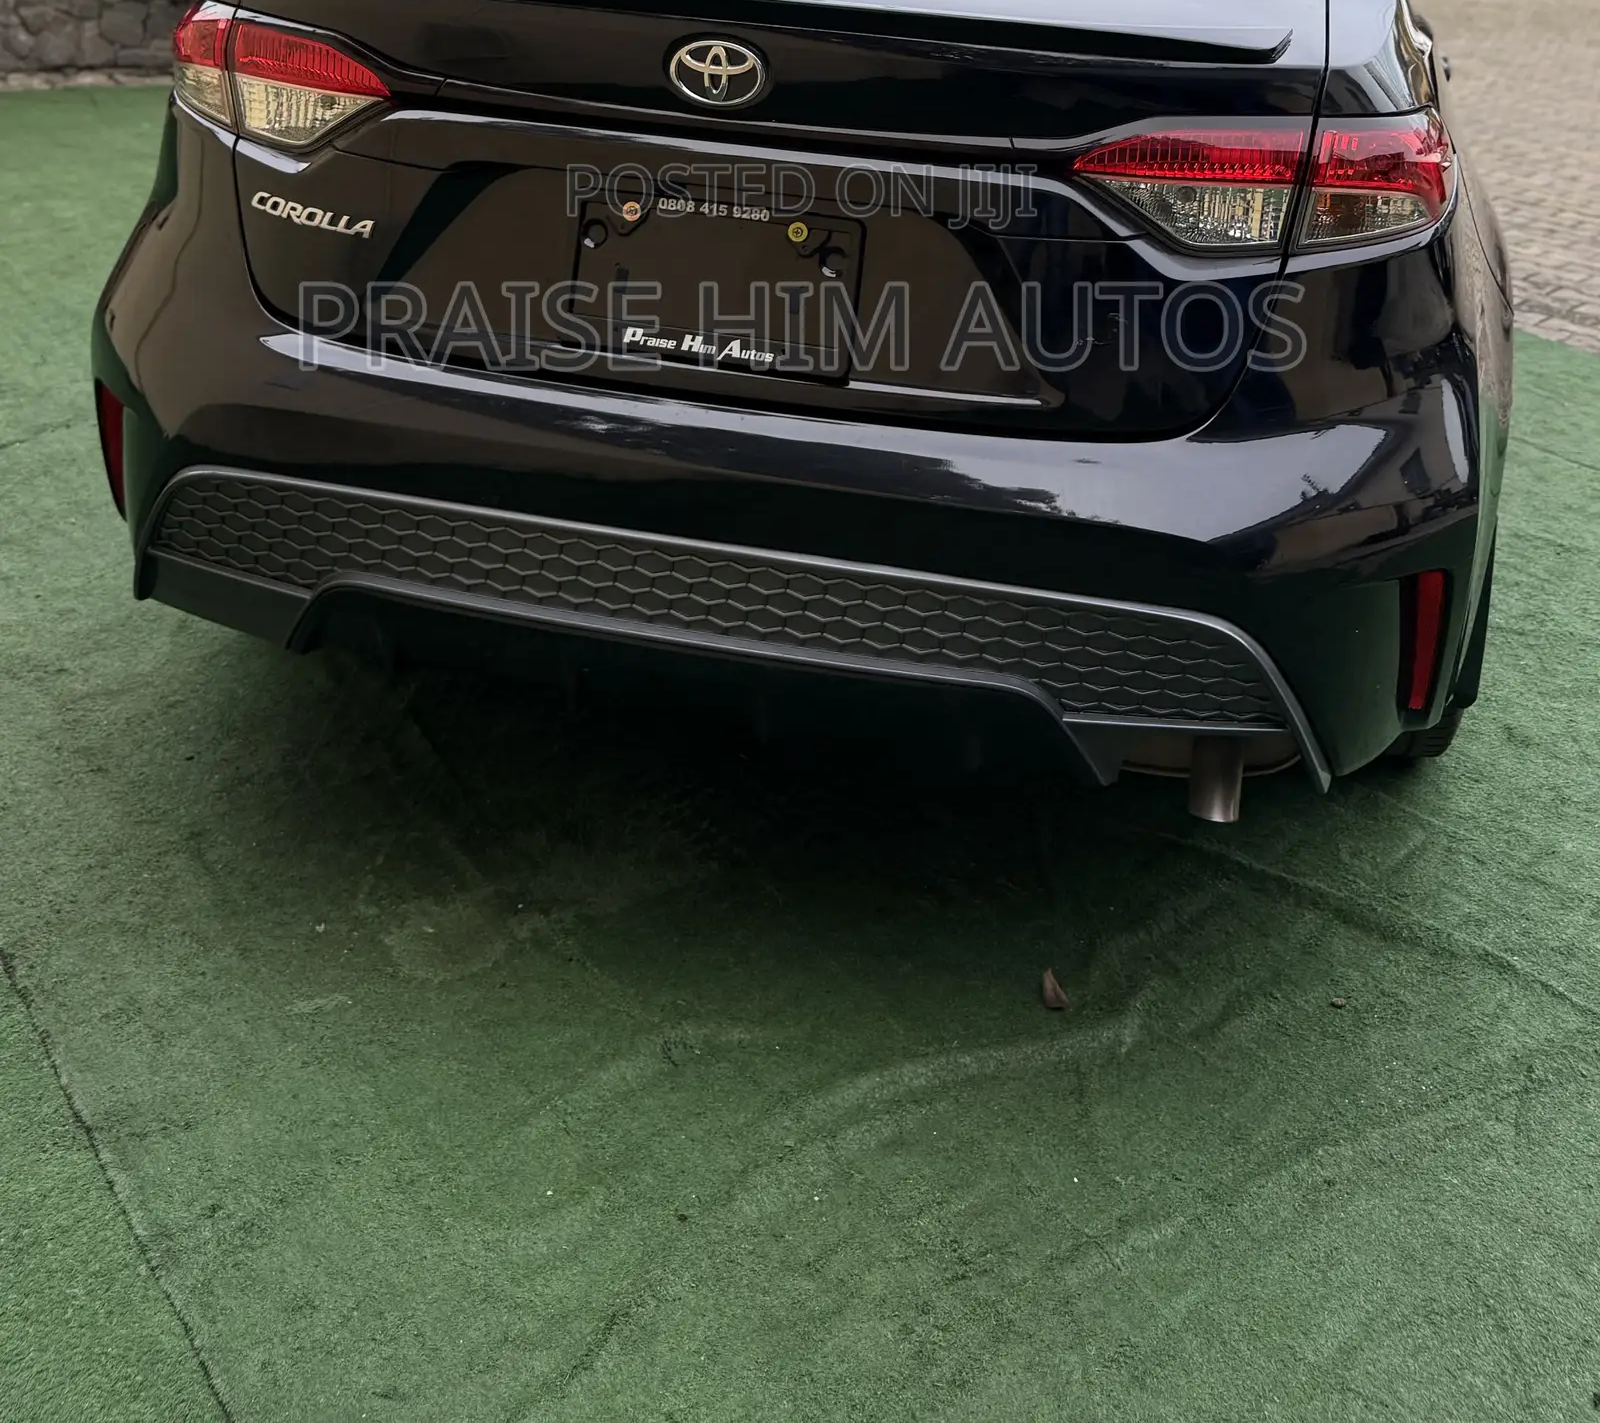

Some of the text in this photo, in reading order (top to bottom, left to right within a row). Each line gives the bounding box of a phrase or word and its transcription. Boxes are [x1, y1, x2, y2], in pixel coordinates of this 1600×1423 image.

[251, 191, 375, 239] COROLLA
[699, 202, 728, 217] 415
[732, 206, 770, 222] 9280
